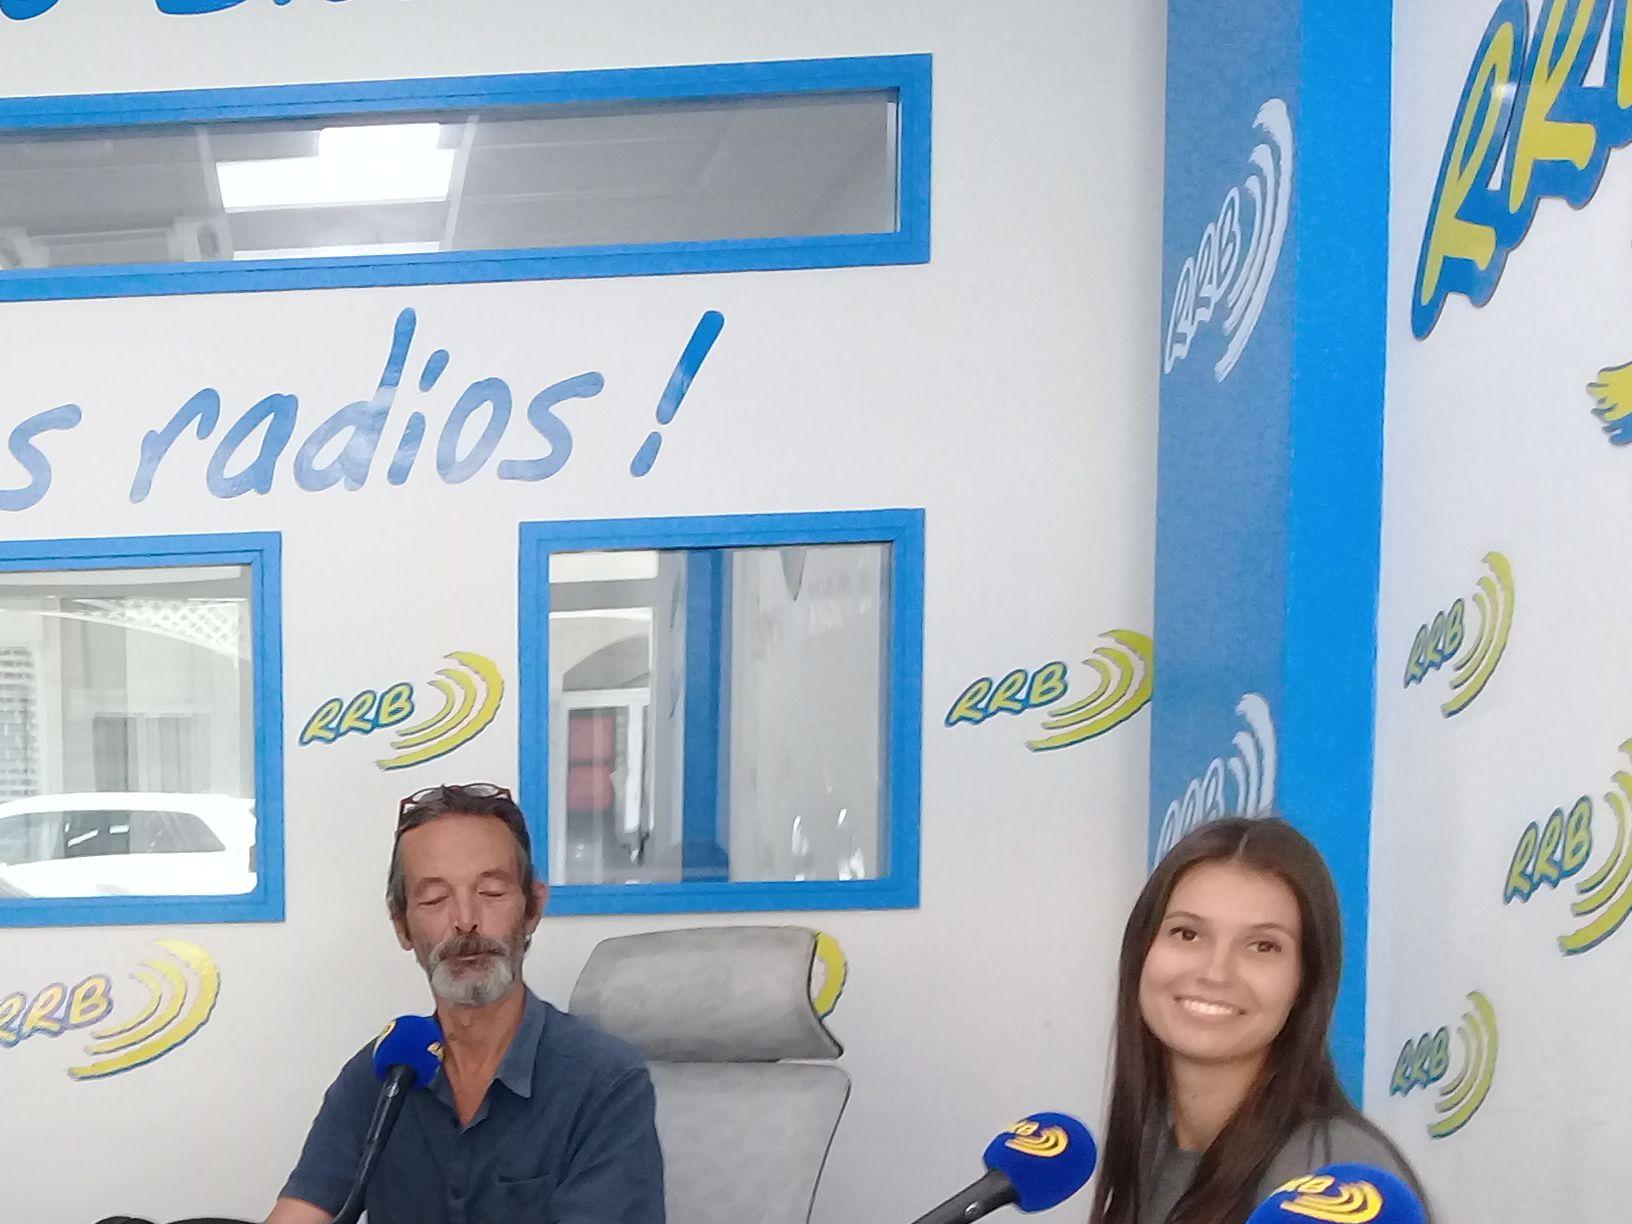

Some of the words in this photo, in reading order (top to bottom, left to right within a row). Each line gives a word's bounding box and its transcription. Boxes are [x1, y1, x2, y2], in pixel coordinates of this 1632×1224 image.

[1411, 0, 1632, 341] RR
[129, 307, 605, 504] radios
[1404, 598, 1465, 689] RRB
[298, 682, 415, 746] RRB
[944, 660, 1068, 728] RRB
[1503, 796, 1594, 905] RRB
[1389, 1025, 1449, 1096] RRB
